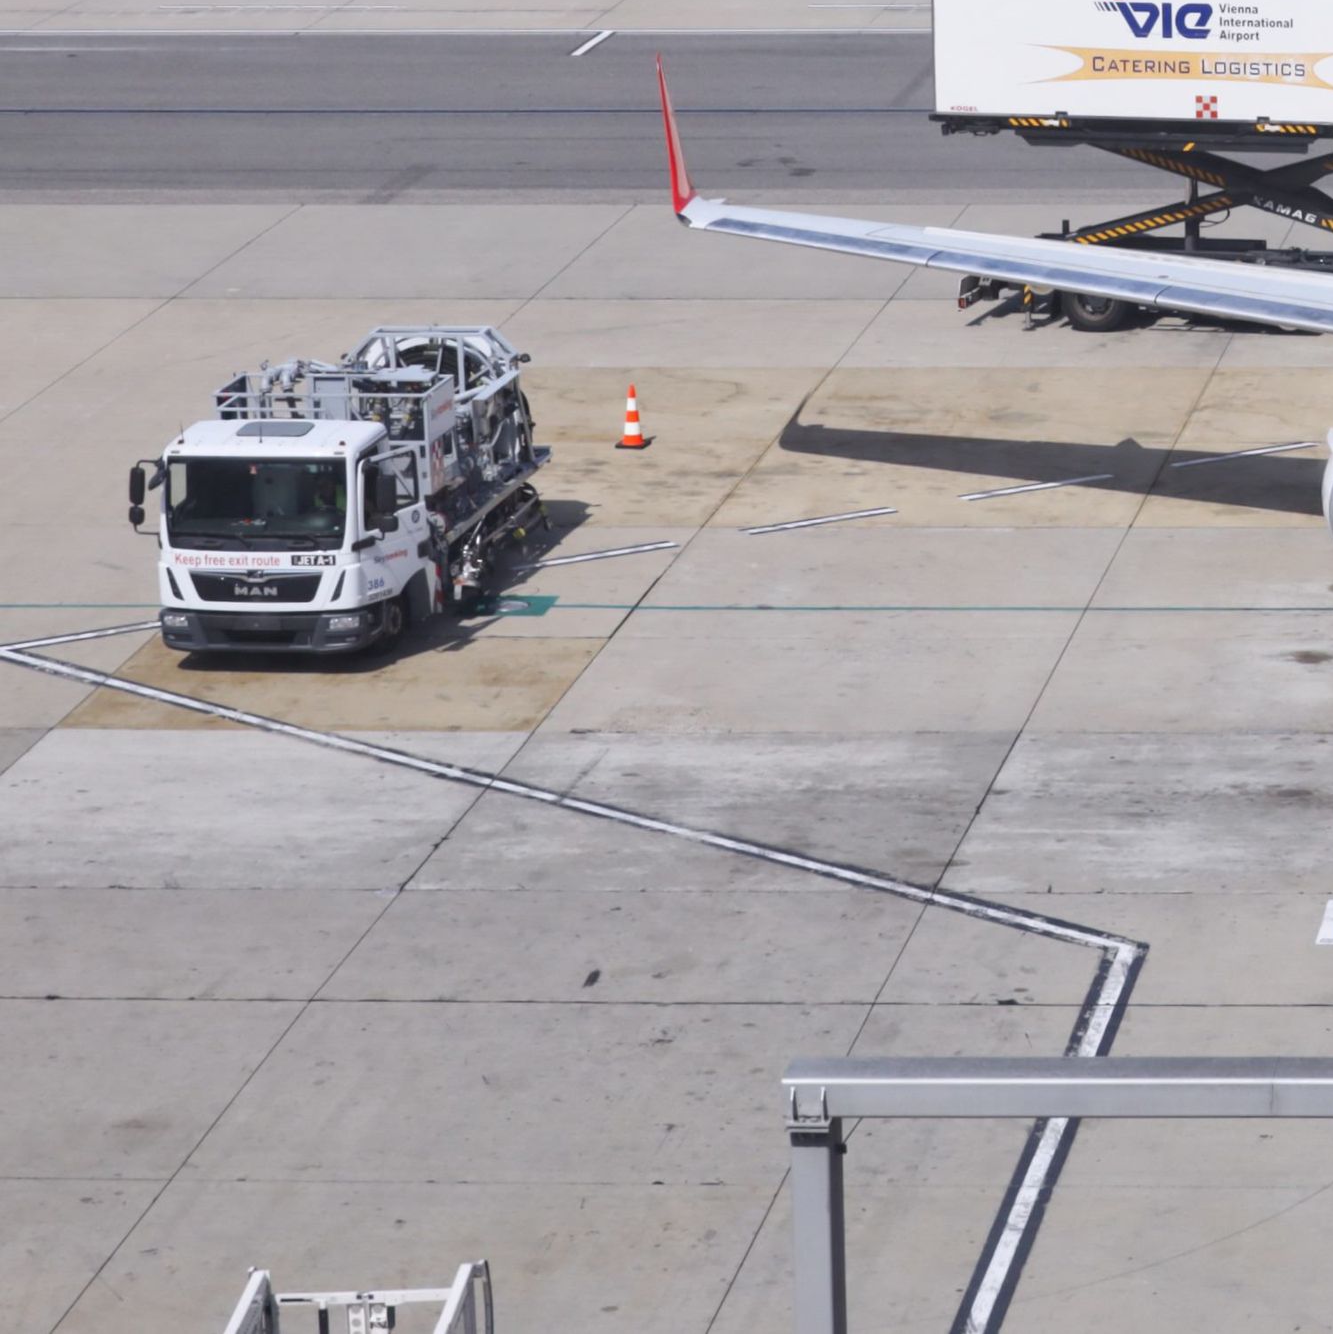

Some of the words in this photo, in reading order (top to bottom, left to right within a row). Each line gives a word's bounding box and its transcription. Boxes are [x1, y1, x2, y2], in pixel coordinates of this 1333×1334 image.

[1219, 3, 1259, 15] Vienna
[1219, 17, 1294, 29] International
[1219, 30, 1260, 42] Airport
[1253, 195, 1318, 224] KAMAG
[174, 555, 202, 567] Keep
[204, 554, 226, 565] free
[229, 554, 250, 566] exit
[252, 555, 281, 566] route
[298, 555, 316, 565] JET
[317, 555, 334, 565] A-1
[234, 586, 278, 596] MAN
